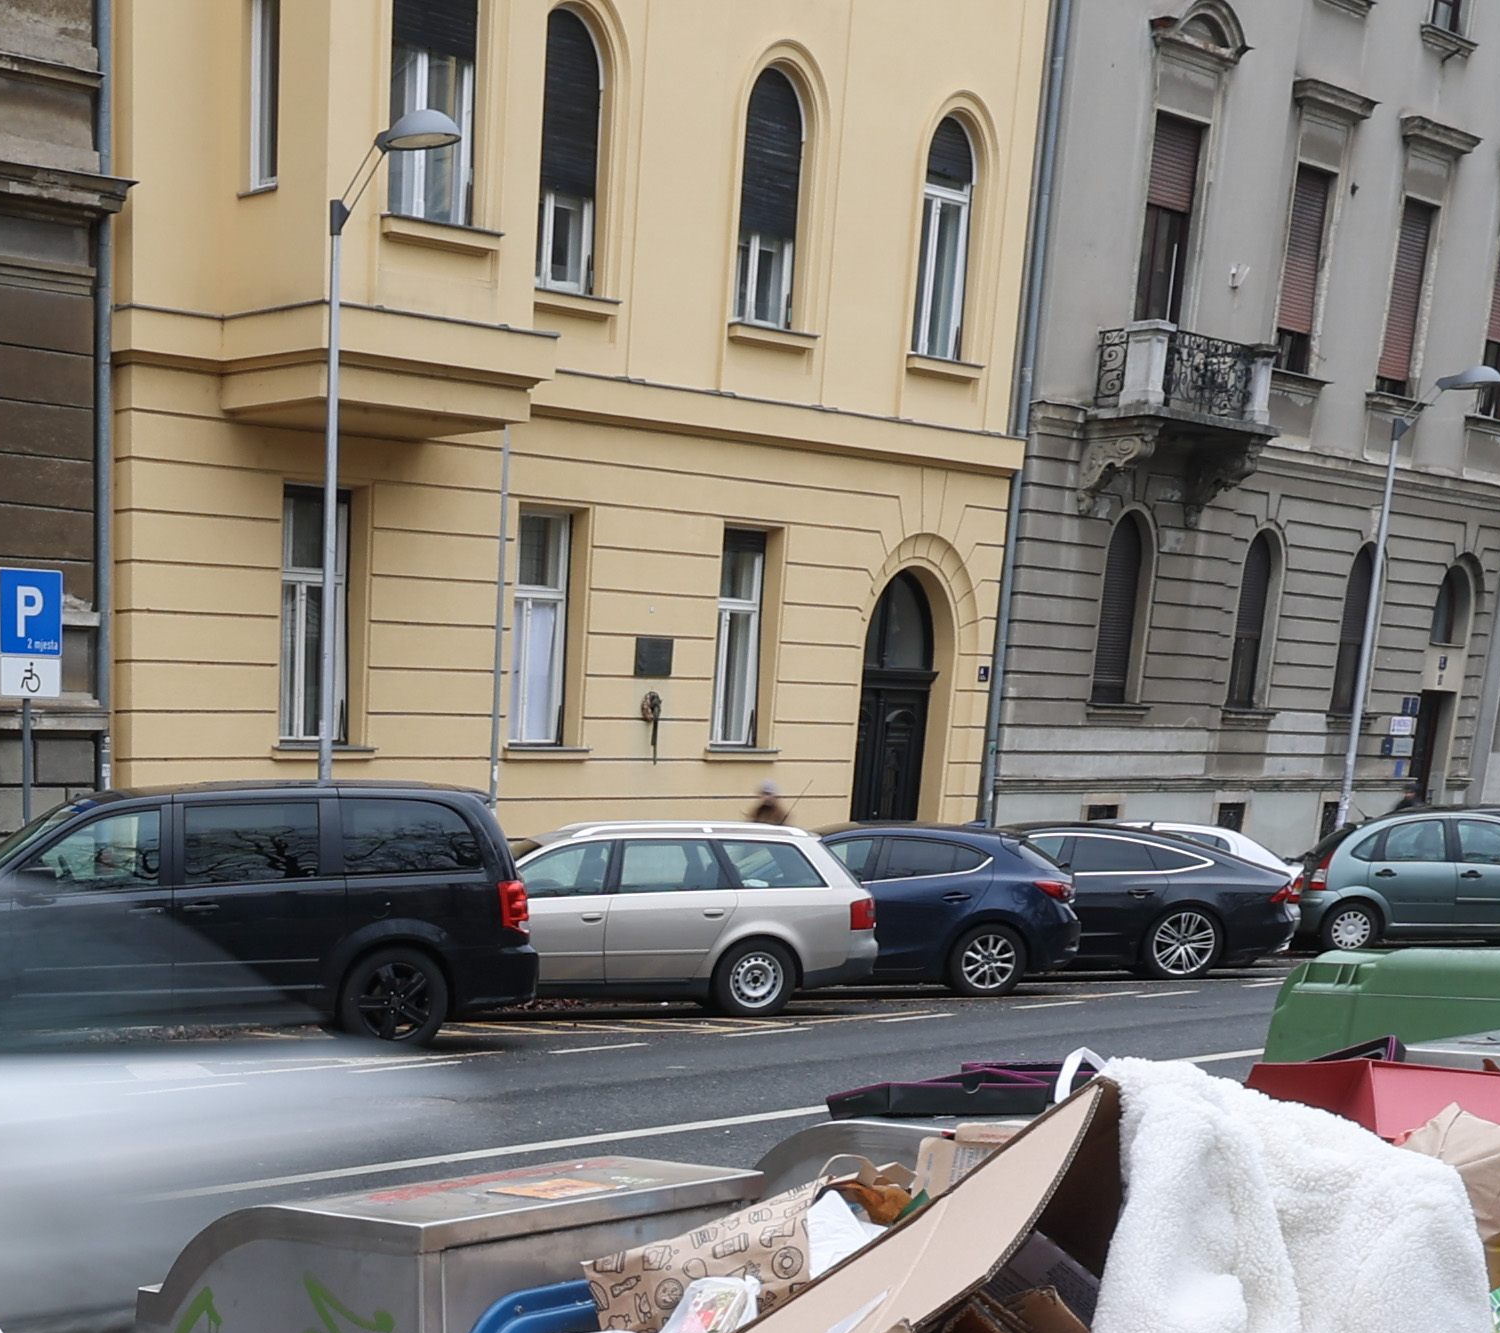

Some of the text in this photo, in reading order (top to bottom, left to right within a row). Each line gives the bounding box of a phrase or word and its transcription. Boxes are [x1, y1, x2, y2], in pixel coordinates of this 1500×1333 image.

[16, 584, 44, 638] P
[27, 637, 59, 653] 2 mjesta
